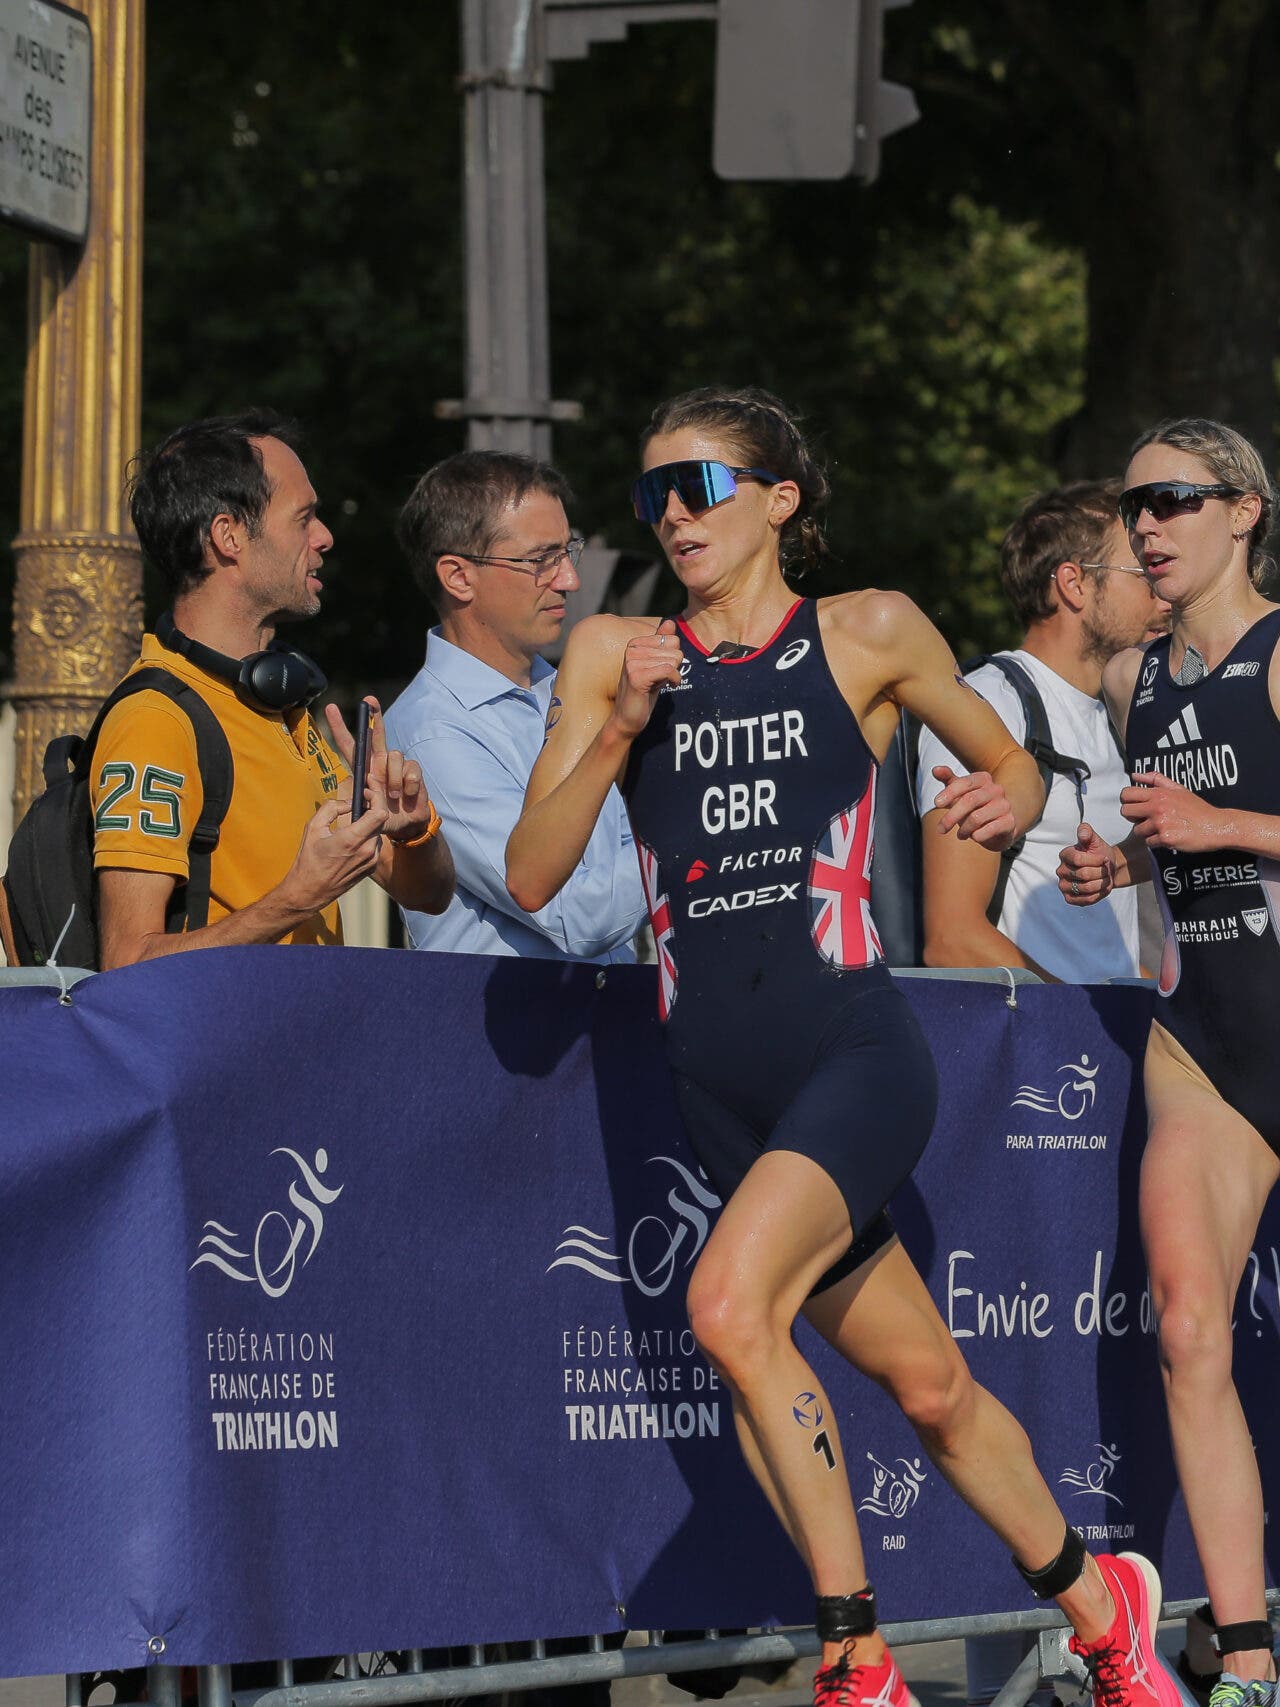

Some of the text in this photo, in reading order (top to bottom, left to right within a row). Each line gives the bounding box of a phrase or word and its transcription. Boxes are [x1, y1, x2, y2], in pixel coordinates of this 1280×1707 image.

[25, 84, 52, 128] des
[674, 709, 809, 772] POTTER
[95, 761, 186, 840] 25
[701, 779, 779, 835] GBR
[719, 846, 803, 874] FACTOR
[687, 881, 802, 919] CADEX
[1174, 916, 1238, 933] BAHRAIN
[1175, 929, 1240, 944] VICTORIOUS
[1006, 1134, 1108, 1150] PARA TRIATHLON
[948, 1250, 1054, 1338] Envie
[1074, 1250, 1129, 1337] de
[206, 1326, 335, 1364] FÉDÉRATION
[562, 1324, 697, 1358] FÉDÉRATIO
[209, 1372, 336, 1406] FRANÇAISE DE
[563, 1366, 719, 1400] FRANÇAISE DE
[212, 1410, 339, 1451] TRIATHLON
[565, 1402, 720, 1441] TRIATHLON
[812, 1428, 837, 1473] 1
[882, 1535, 906, 1551] RAID
[1087, 1524, 1135, 1540] TRIATHLON
